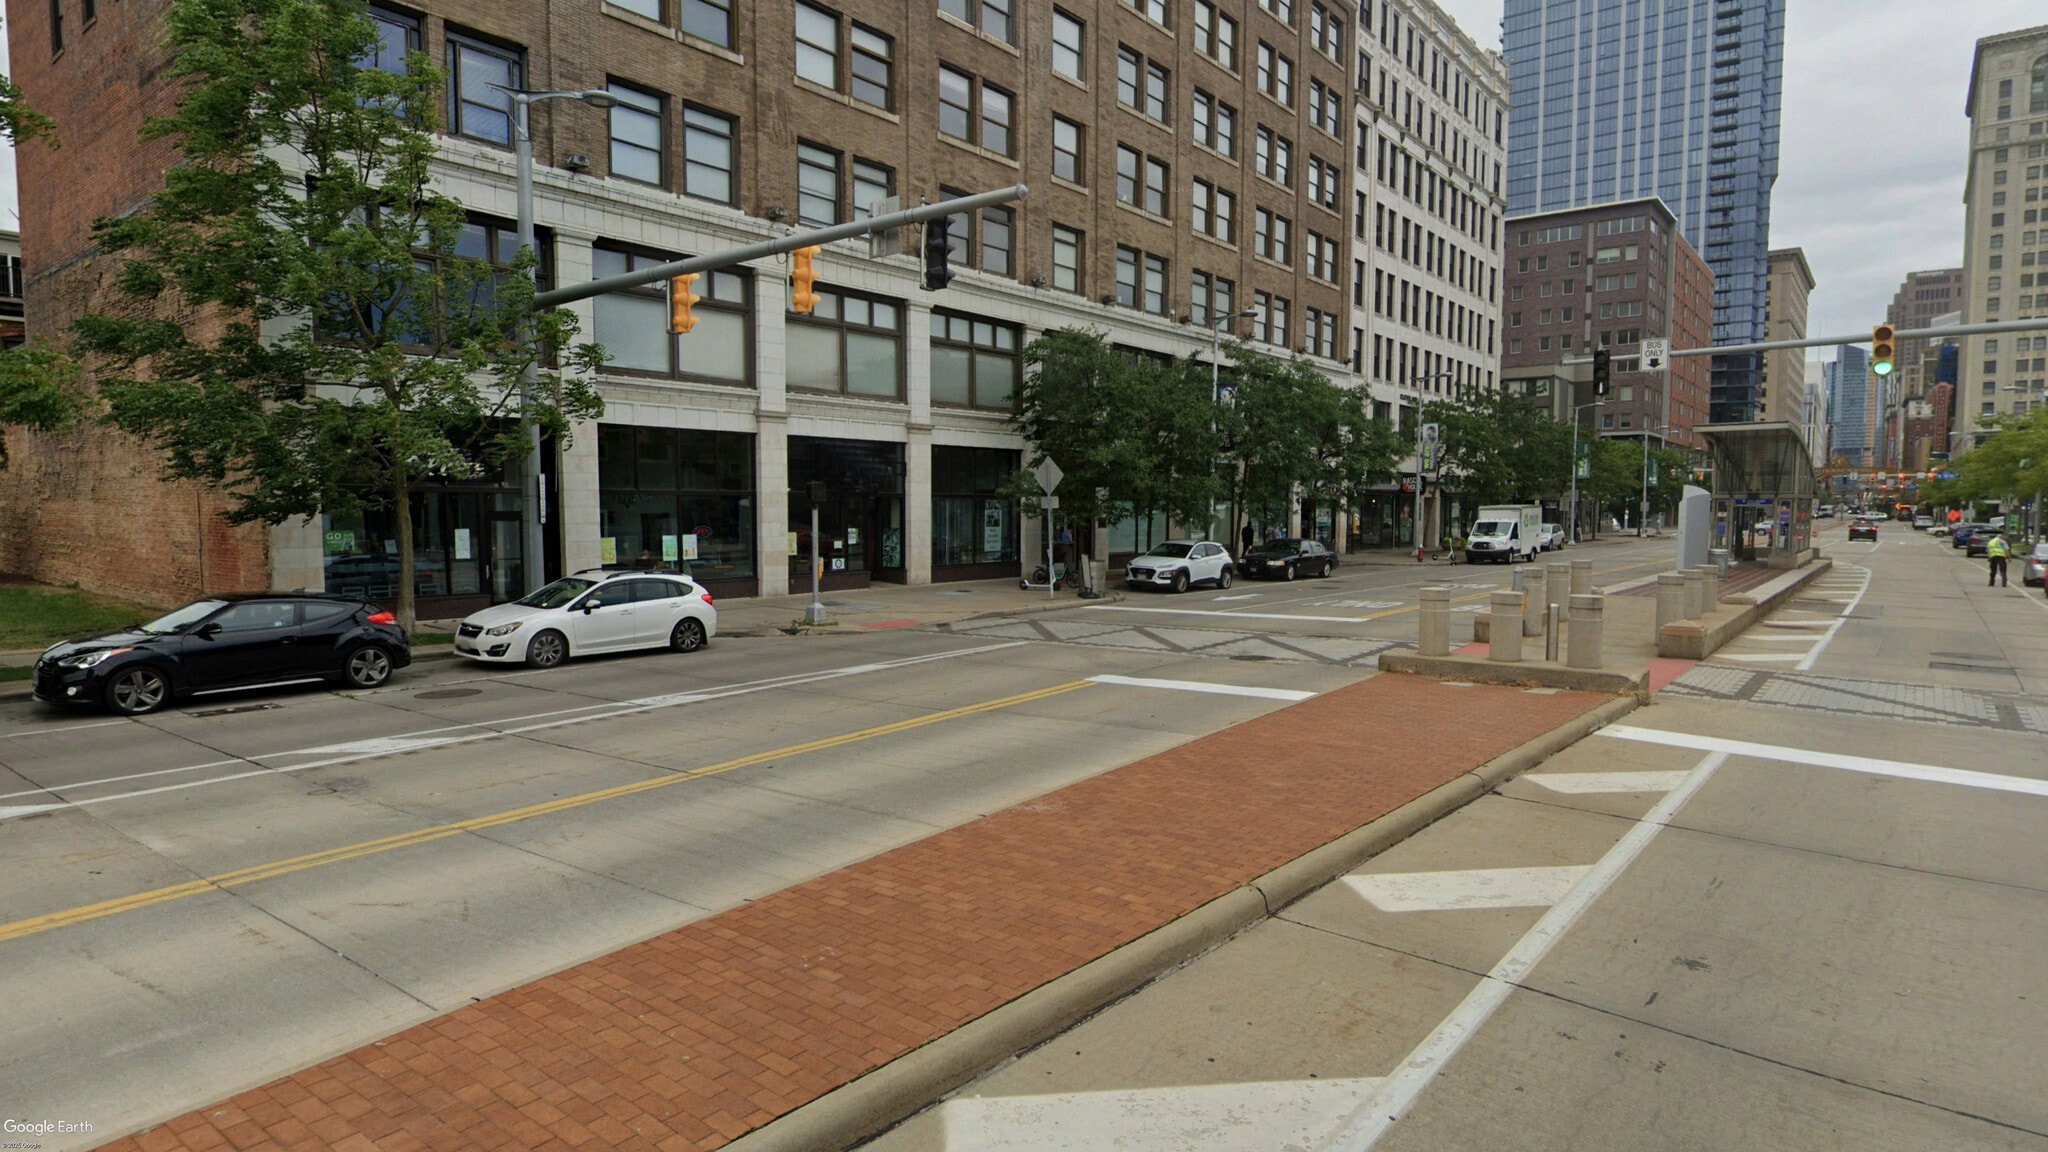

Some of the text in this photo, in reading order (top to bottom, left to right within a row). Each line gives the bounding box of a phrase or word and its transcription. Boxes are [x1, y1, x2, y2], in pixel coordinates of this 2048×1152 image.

[1647, 341, 1662, 349] BUS
[1645, 349, 1664, 357] ONLY
[326, 532, 342, 540] GO
